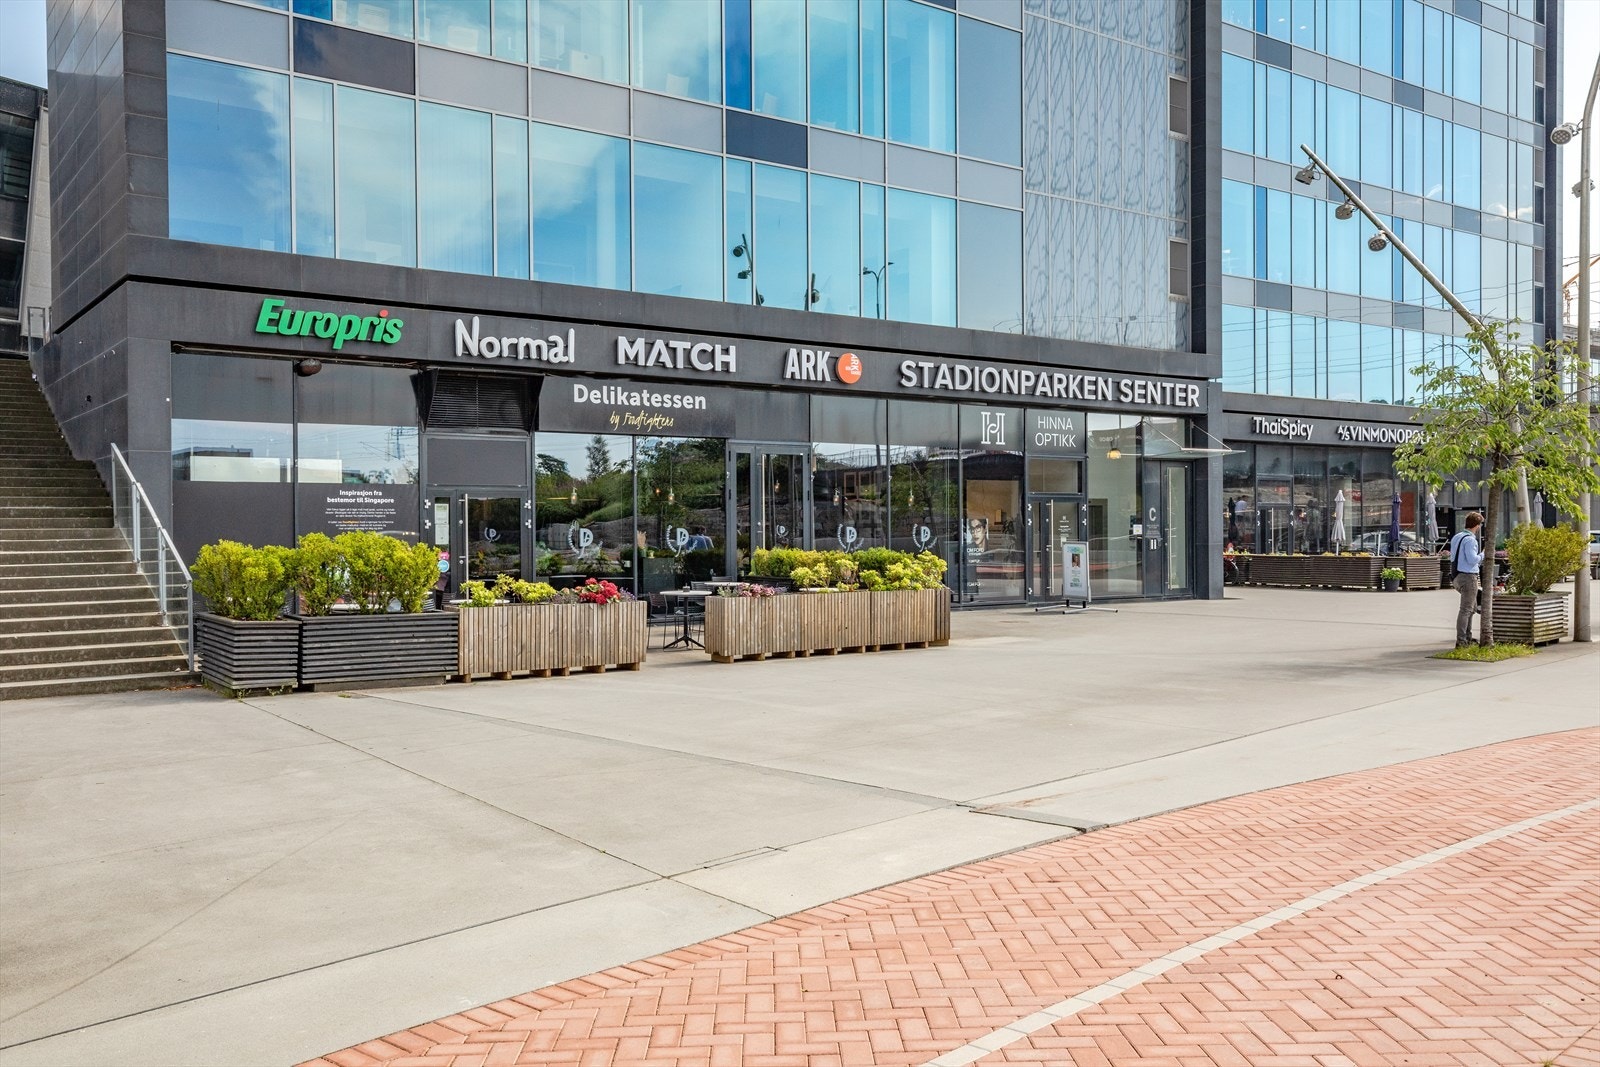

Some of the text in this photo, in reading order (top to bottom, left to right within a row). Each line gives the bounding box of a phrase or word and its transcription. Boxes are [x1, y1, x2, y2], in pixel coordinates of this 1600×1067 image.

[255, 298, 404, 349] Europris
[455, 316, 575, 363] Normal
[616, 336, 737, 373] MATCH
[783, 348, 831, 382] ARK
[573, 383, 707, 410] Delikatessen
[900, 360, 1200, 408] STADIONPARKEN SENTER
[609, 411, 620, 431] by
[1037, 415, 1074, 431] HINNA
[1253, 416, 1314, 441] ThaiSpicy
[1034, 432, 1077, 448] OPTIKK
[1149, 507, 1157, 521] C
